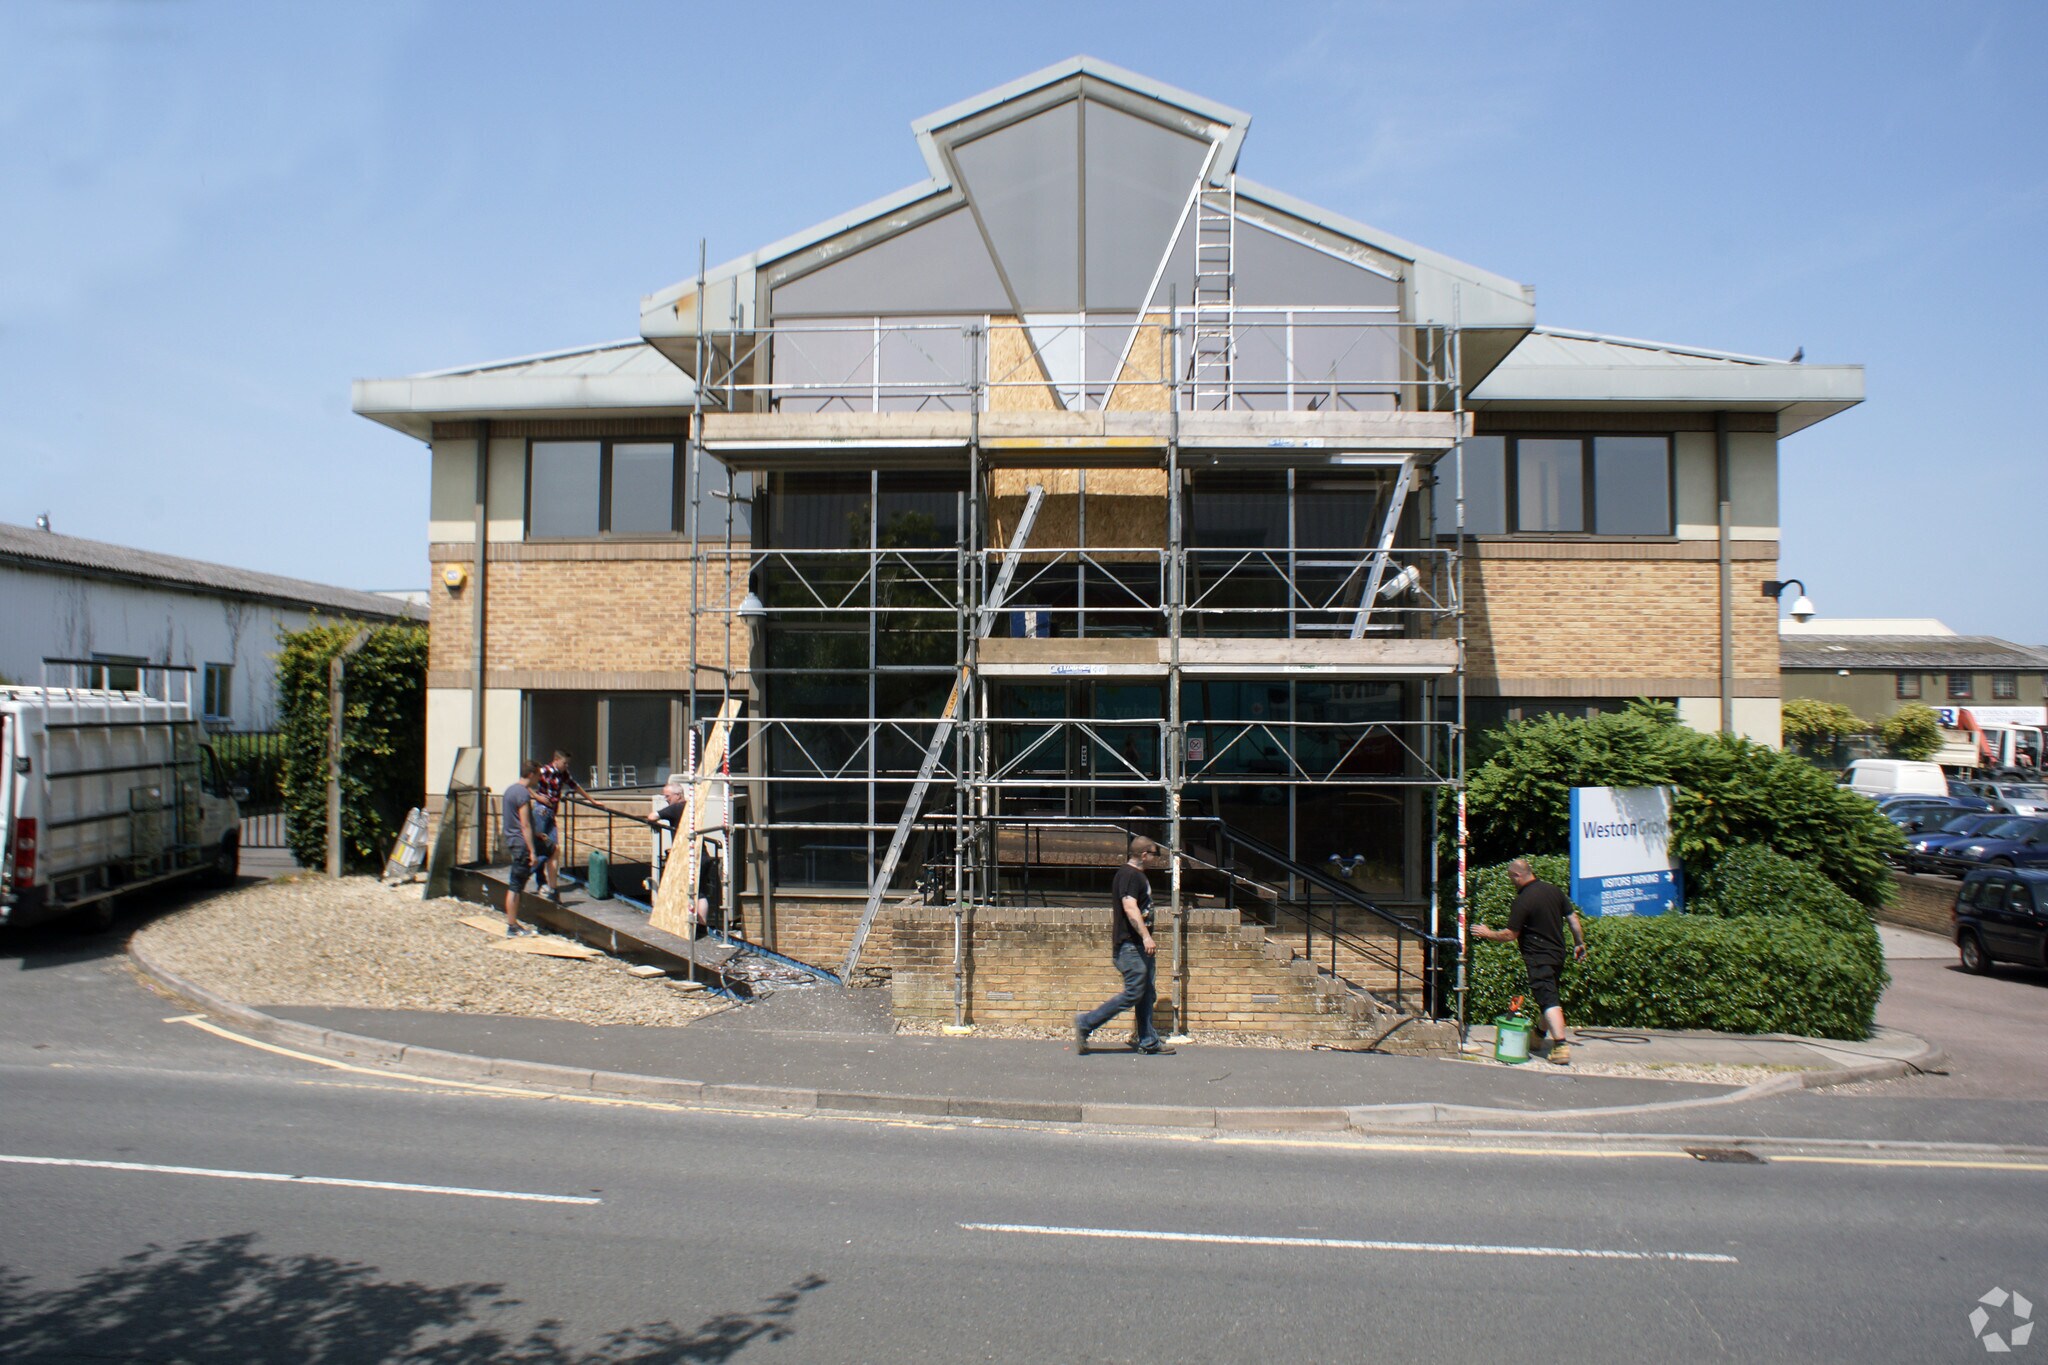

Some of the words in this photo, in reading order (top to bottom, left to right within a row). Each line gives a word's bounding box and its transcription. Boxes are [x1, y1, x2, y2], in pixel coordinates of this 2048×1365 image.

[1601, 876, 1631, 888] VISITORS
[1631, 873, 1659, 884] PARKING
[1601, 888, 1634, 900] DELIVERIES
[1601, 903, 1634, 915] RECEPTION
